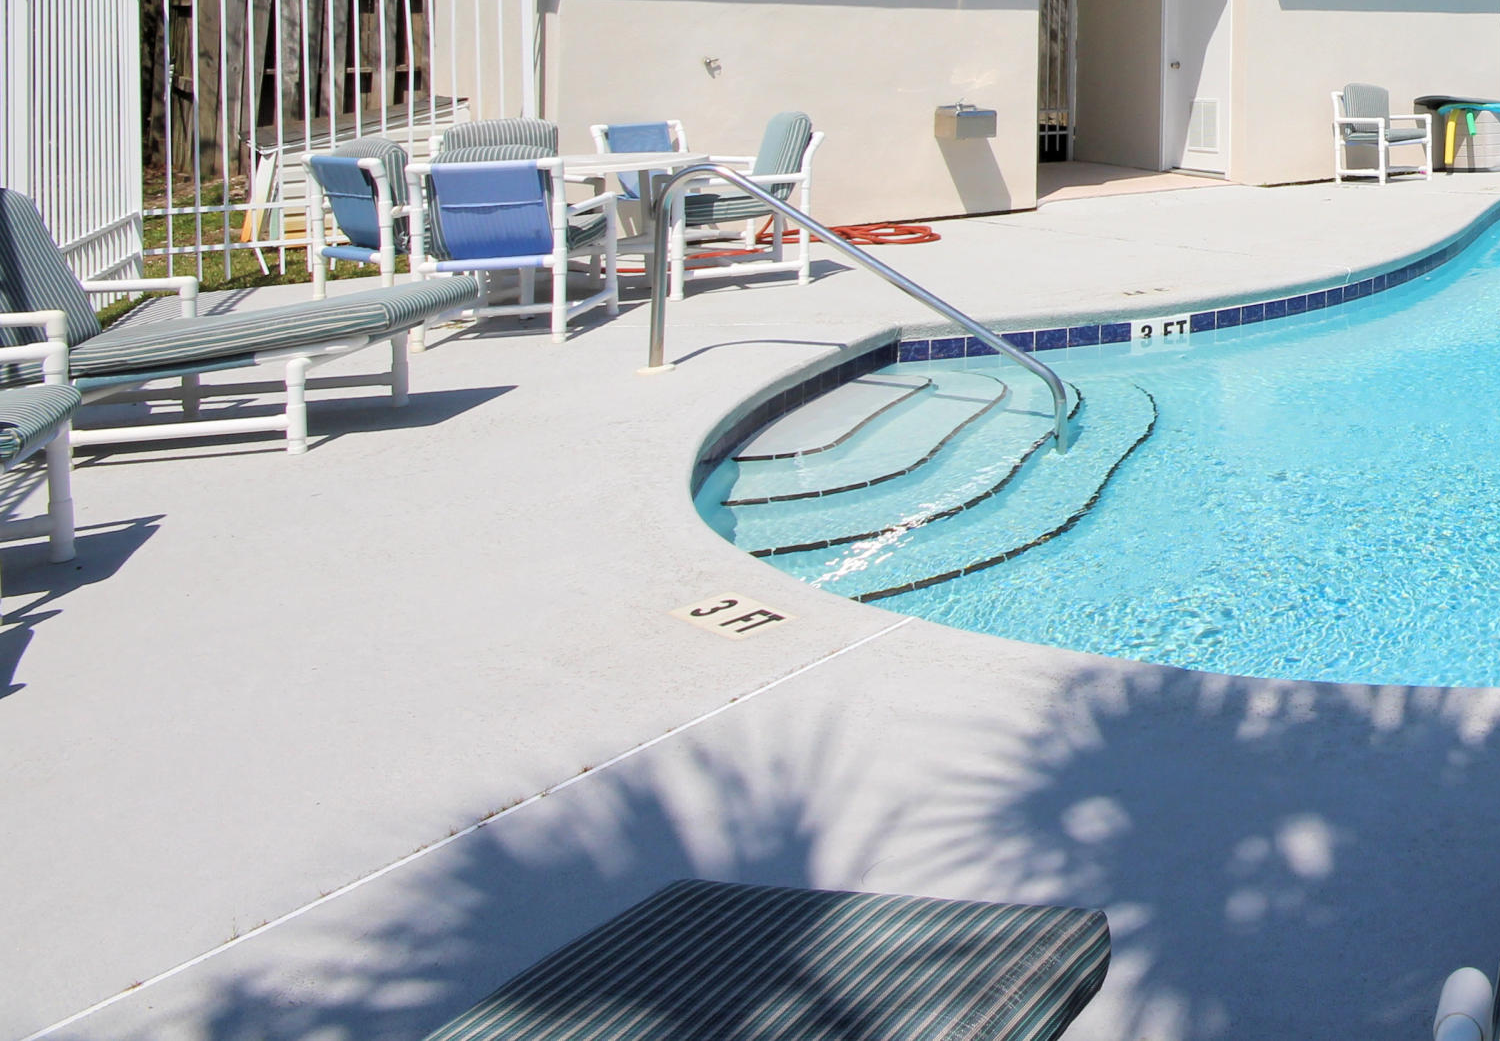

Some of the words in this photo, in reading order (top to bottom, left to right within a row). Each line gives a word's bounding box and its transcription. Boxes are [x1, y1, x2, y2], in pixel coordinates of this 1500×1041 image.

[1141, 325, 1153, 339] 3
[1163, 319, 1187, 337] FT
[690, 599, 738, 617] 3
[718, 609, 786, 633] FT
